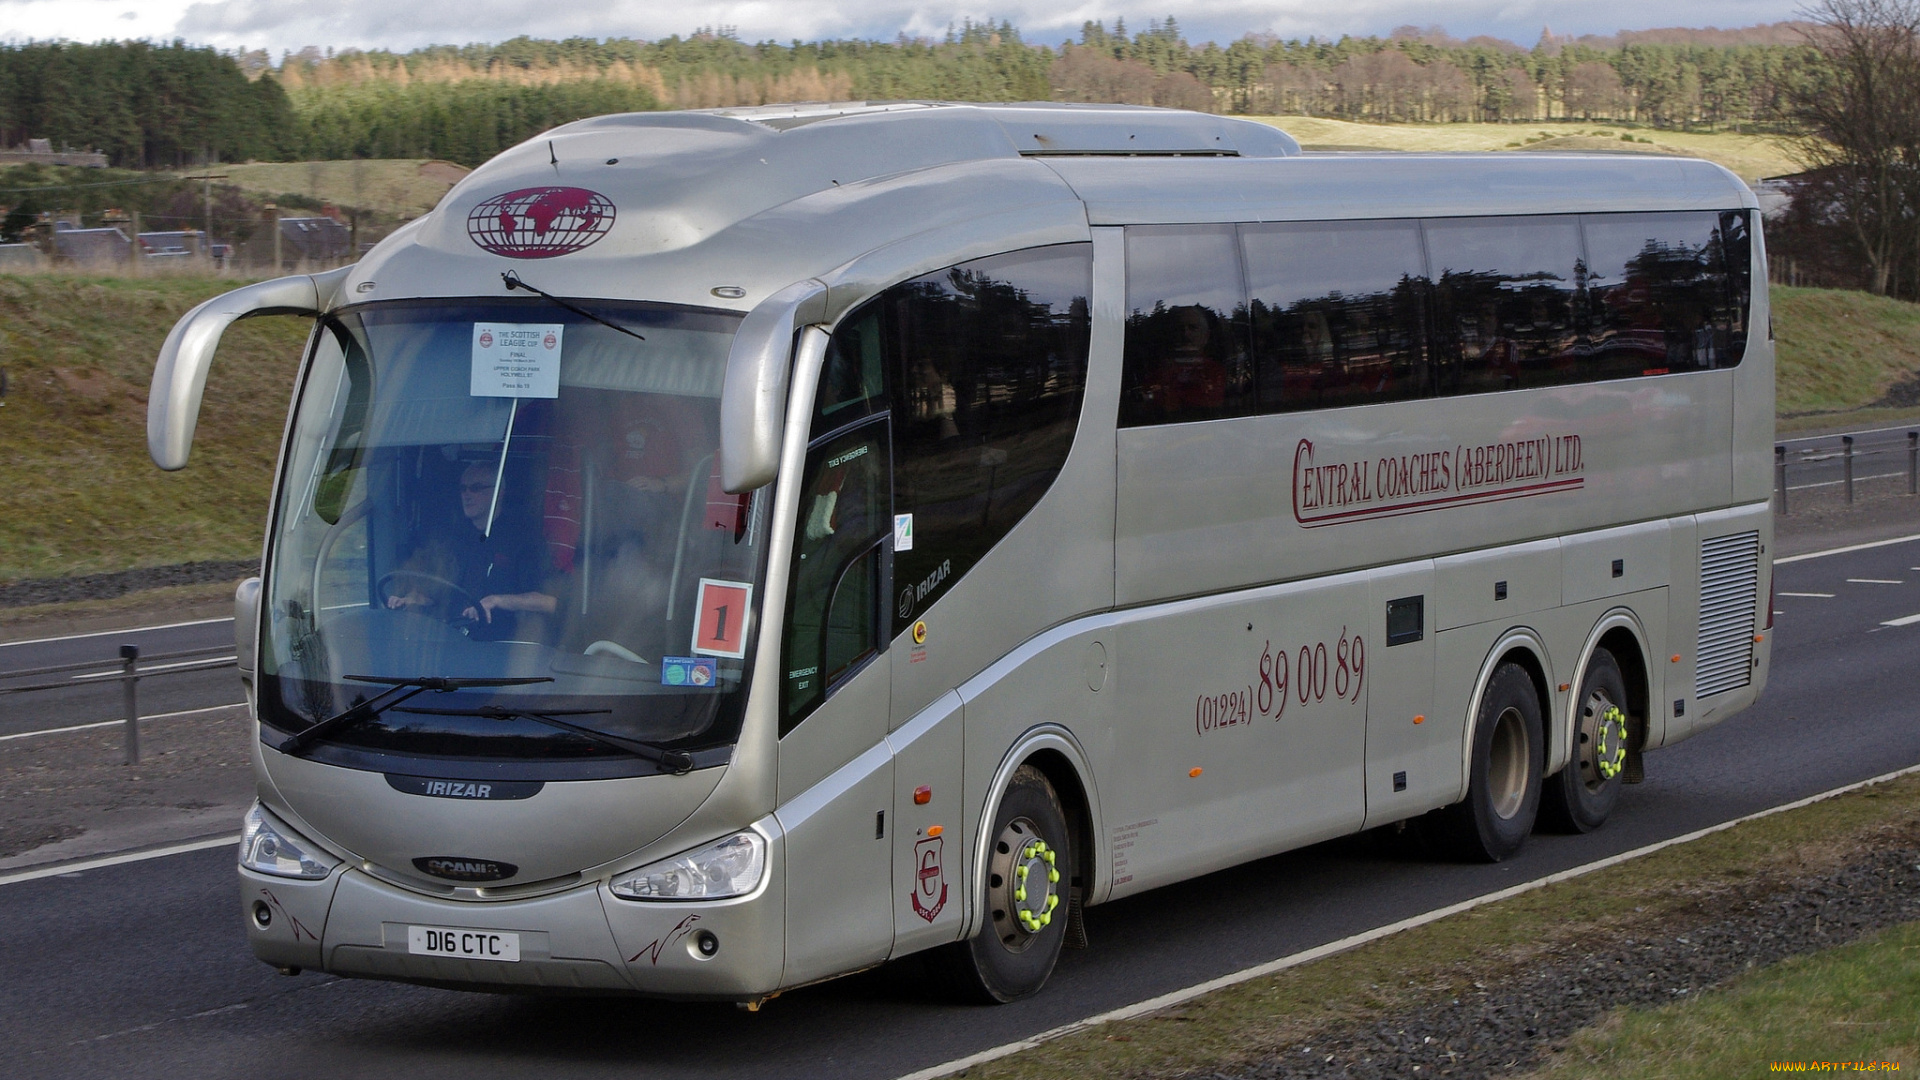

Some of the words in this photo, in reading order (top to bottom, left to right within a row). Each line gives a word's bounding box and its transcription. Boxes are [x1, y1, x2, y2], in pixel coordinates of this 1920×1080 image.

[500, 339, 526, 347] LEAGUE
[510, 330, 541, 339] SCOTTISH
[1292, 438, 1372, 523] CENTRAL
[1376, 450, 1451, 500] COACHES
[1453, 434, 1551, 493] (ABERDEEN)
[1555, 434, 1585, 474] LTD.
[916, 558, 951, 602] IRIZAR
[710, 604, 729, 642] 1
[788, 666, 818, 679] EMERGENCY
[1196, 685, 1253, 737] (01224)
[1258, 640, 1289, 722] 89
[1298, 642, 1328, 706] 00
[1335, 625, 1364, 705] 89
[798, 680, 810, 690] EXIT
[426, 781, 492, 798] IRIZAR
[426, 930, 457, 953] D16
[462, 933, 501, 956] CTC
